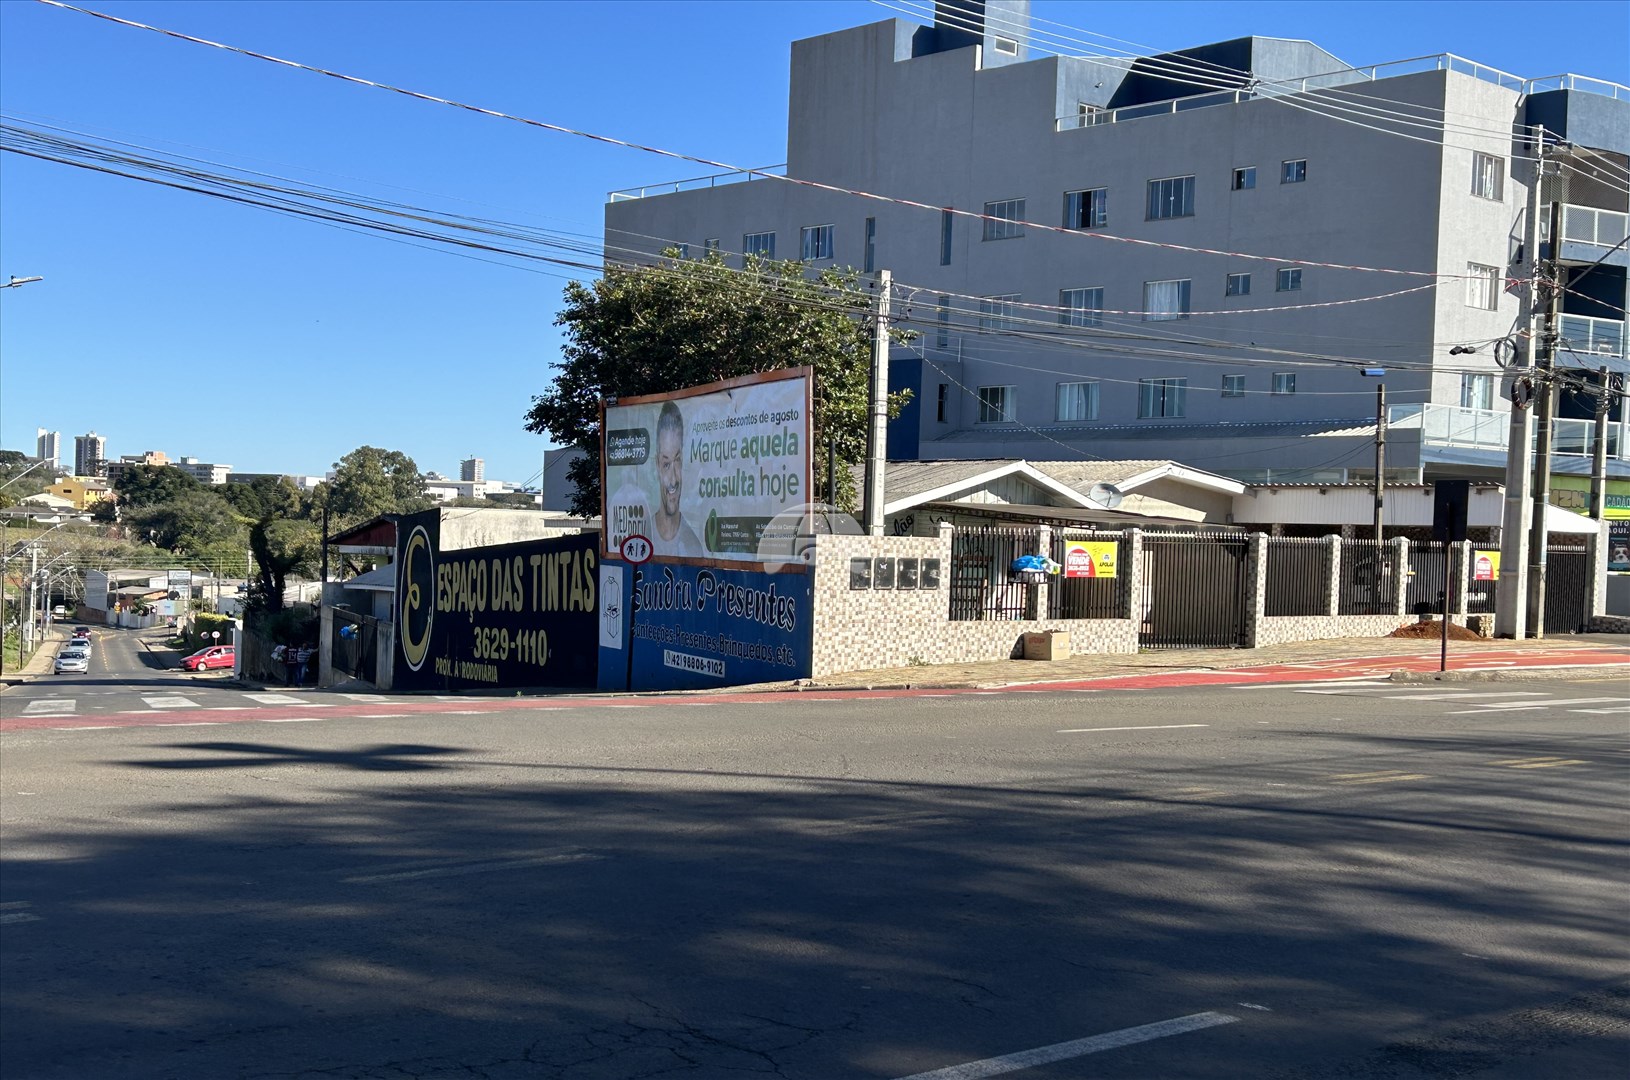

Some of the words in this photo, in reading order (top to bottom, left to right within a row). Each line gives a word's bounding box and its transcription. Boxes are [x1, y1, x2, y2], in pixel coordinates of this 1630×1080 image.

[692, 420, 718, 435] Aproveite
[718, 420, 726, 430] os
[726, 413, 758, 428] descontos
[759, 411, 769, 424] de
[771, 409, 799, 425] agosto
[690, 437, 738, 468] Marque
[740, 426, 799, 465] aquela
[699, 468, 755, 498] consulta
[760, 464, 800, 504] hoje
[613, 505, 628, 533] MED
[436, 559, 488, 623] ESPAÇO
[491, 555, 524, 613] DAS
[529, 548, 596, 613] TINTAS
[696, 569, 797, 633] Presentes
[473, 626, 548, 667] 3629-1110
[461, 660, 499, 683] RODOVIÁRIA
